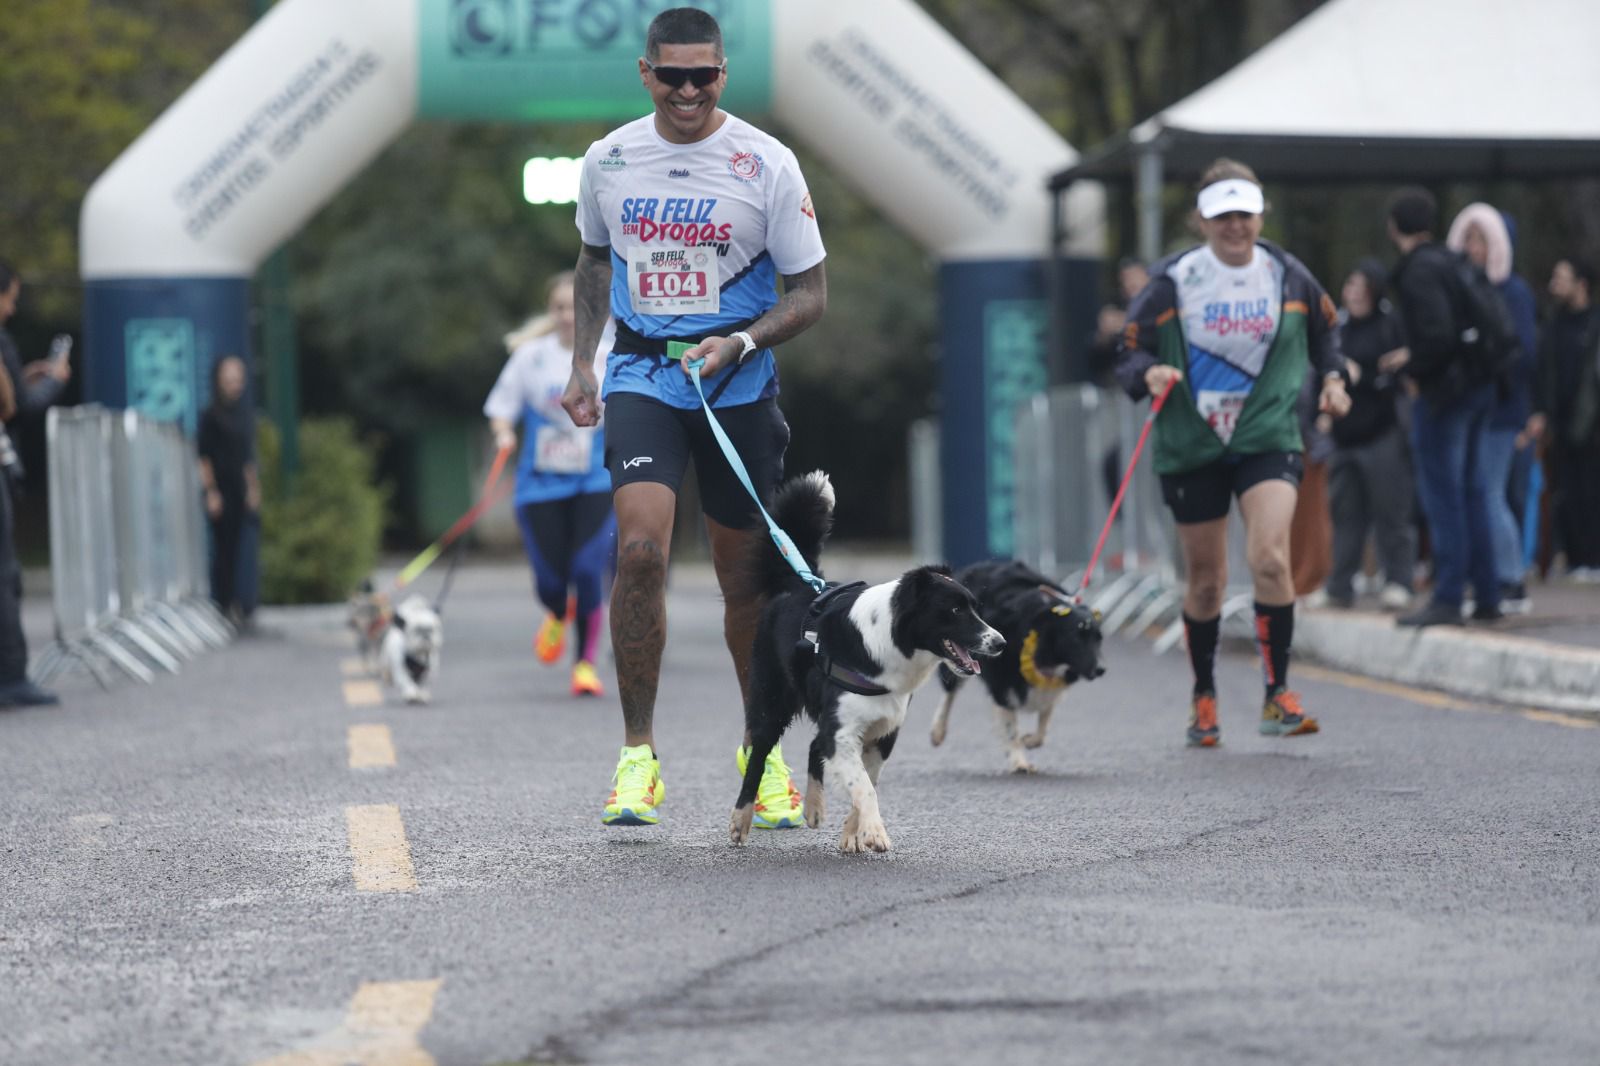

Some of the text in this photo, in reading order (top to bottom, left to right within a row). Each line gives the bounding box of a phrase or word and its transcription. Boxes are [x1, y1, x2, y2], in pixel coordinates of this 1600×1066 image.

[621, 198, 717, 223] SER FELIZ
[623, 216, 733, 247] SEM Drogas
[651, 250, 685, 262] SER FELIZ
[646, 273, 701, 297] 104
